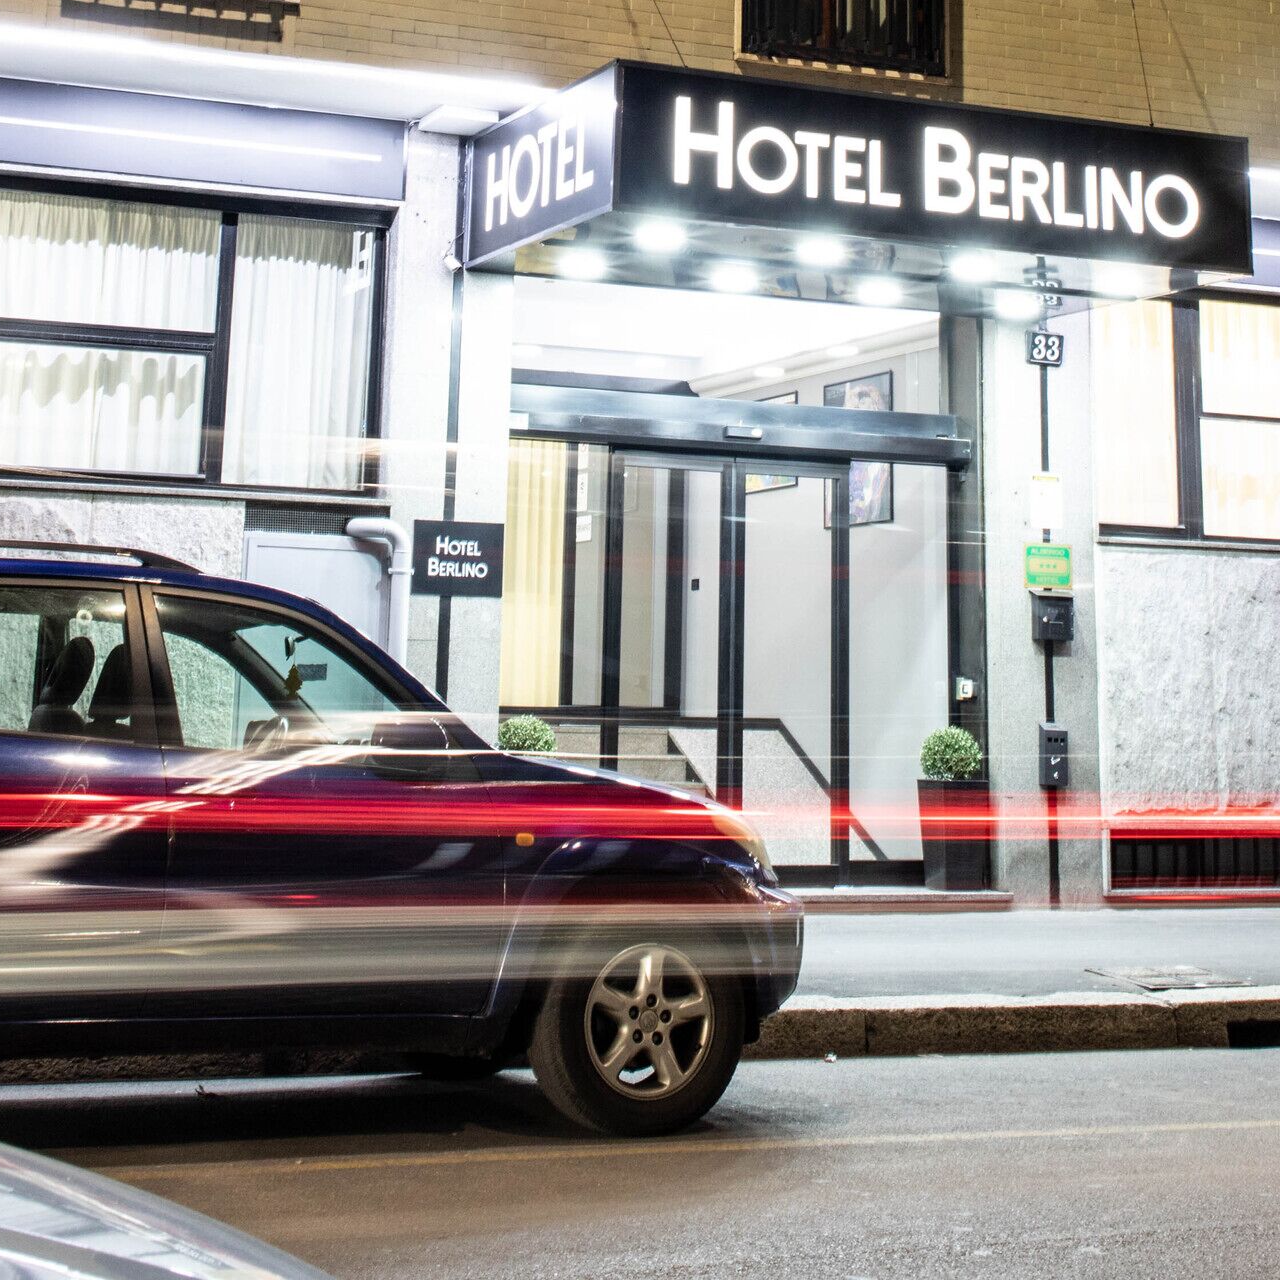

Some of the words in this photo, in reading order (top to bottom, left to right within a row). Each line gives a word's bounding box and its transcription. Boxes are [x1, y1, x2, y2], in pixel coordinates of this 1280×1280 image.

[484, 110, 594, 232] HOTEL
[671, 95, 901, 209] HOTEL
[921, 125, 1201, 239] BERLINO
[1032, 334, 1060, 361] 33
[435, 534, 482, 557] HOTEL
[427, 557, 489, 579] BERLINO
